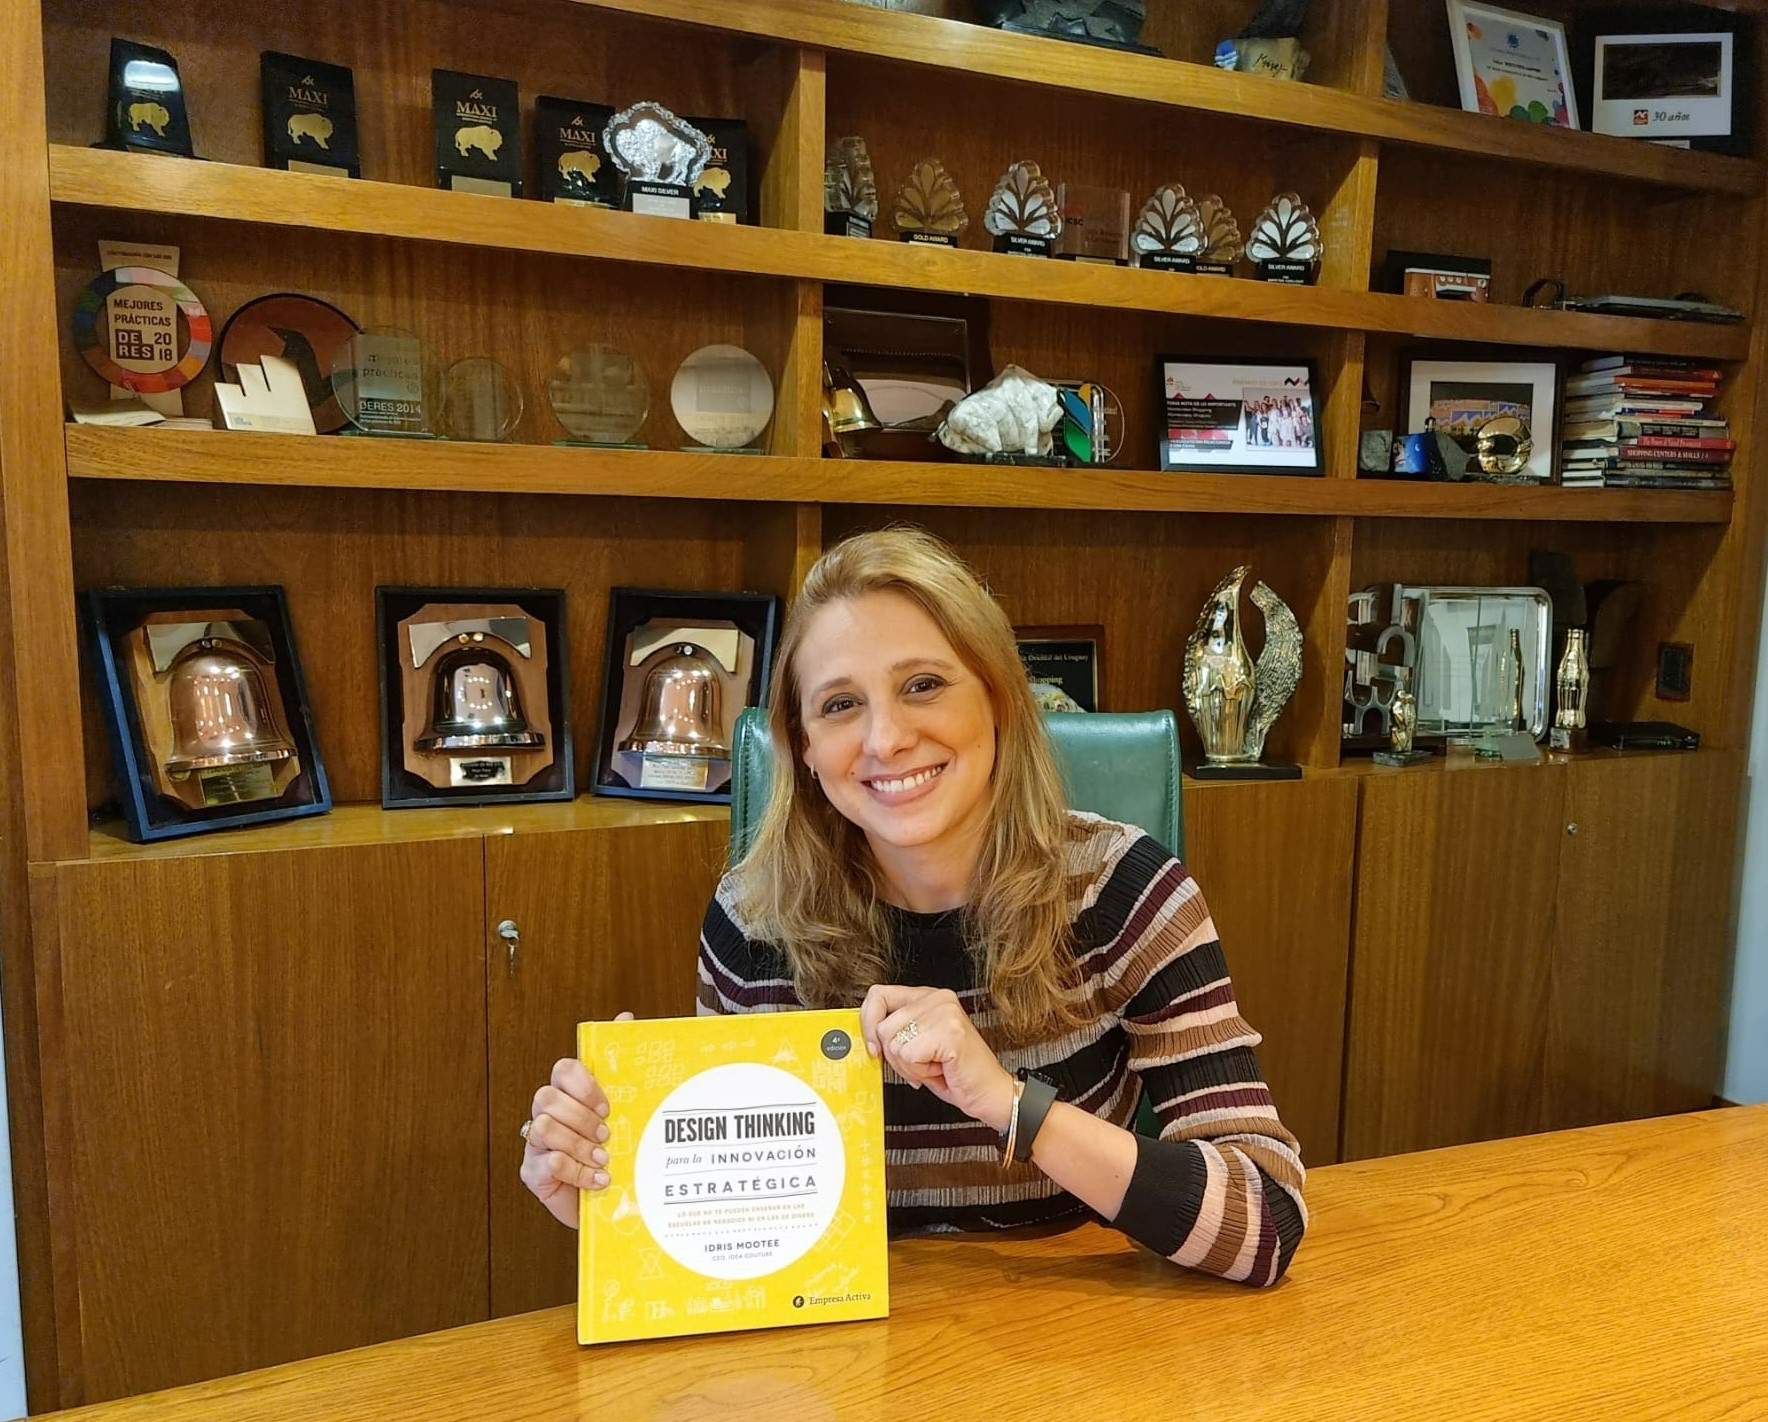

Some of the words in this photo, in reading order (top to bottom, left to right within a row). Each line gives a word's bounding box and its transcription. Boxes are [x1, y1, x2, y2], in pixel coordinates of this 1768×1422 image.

[288, 86, 328, 105] MAXI
[456, 101, 497, 117] MAXI
[1653, 111, 1667, 121] 30
[559, 127, 596, 143] MAXI
[641, 186, 657, 195] MAXI
[658, 187, 679, 196] SILVER
[913, 234, 929, 242] GOLD
[113, 299, 164, 312] MEJORES
[114, 313, 172, 327] PRÁCTICAS
[118, 331, 140, 344] DE
[154, 332, 172, 345] 20
[119, 345, 152, 358] RES
[159, 349, 173, 360] 18
[360, 400, 395, 412] DERES
[396, 402, 421, 414] 2014
[1627, 449, 1652, 457] SHOPPING
[1653, 450, 1677, 458] CENTERS
[664, 1115, 727, 1144] DESIGN
[733, 1111, 816, 1140] THINKING
[665, 1155, 690, 1168] para
[692, 1154, 702, 1164] la
[711, 1145, 816, 1164] INNOVACIÓN
[664, 1175, 817, 1197] ESTRATÉGICA
[724, 1207, 750, 1215] PUEDEN
[704, 1243, 733, 1253] IDRIS
[736, 1239, 780, 1250] MOOTEE
[809, 1295, 844, 1305] Empresa
[845, 1293, 871, 1302] Activa
